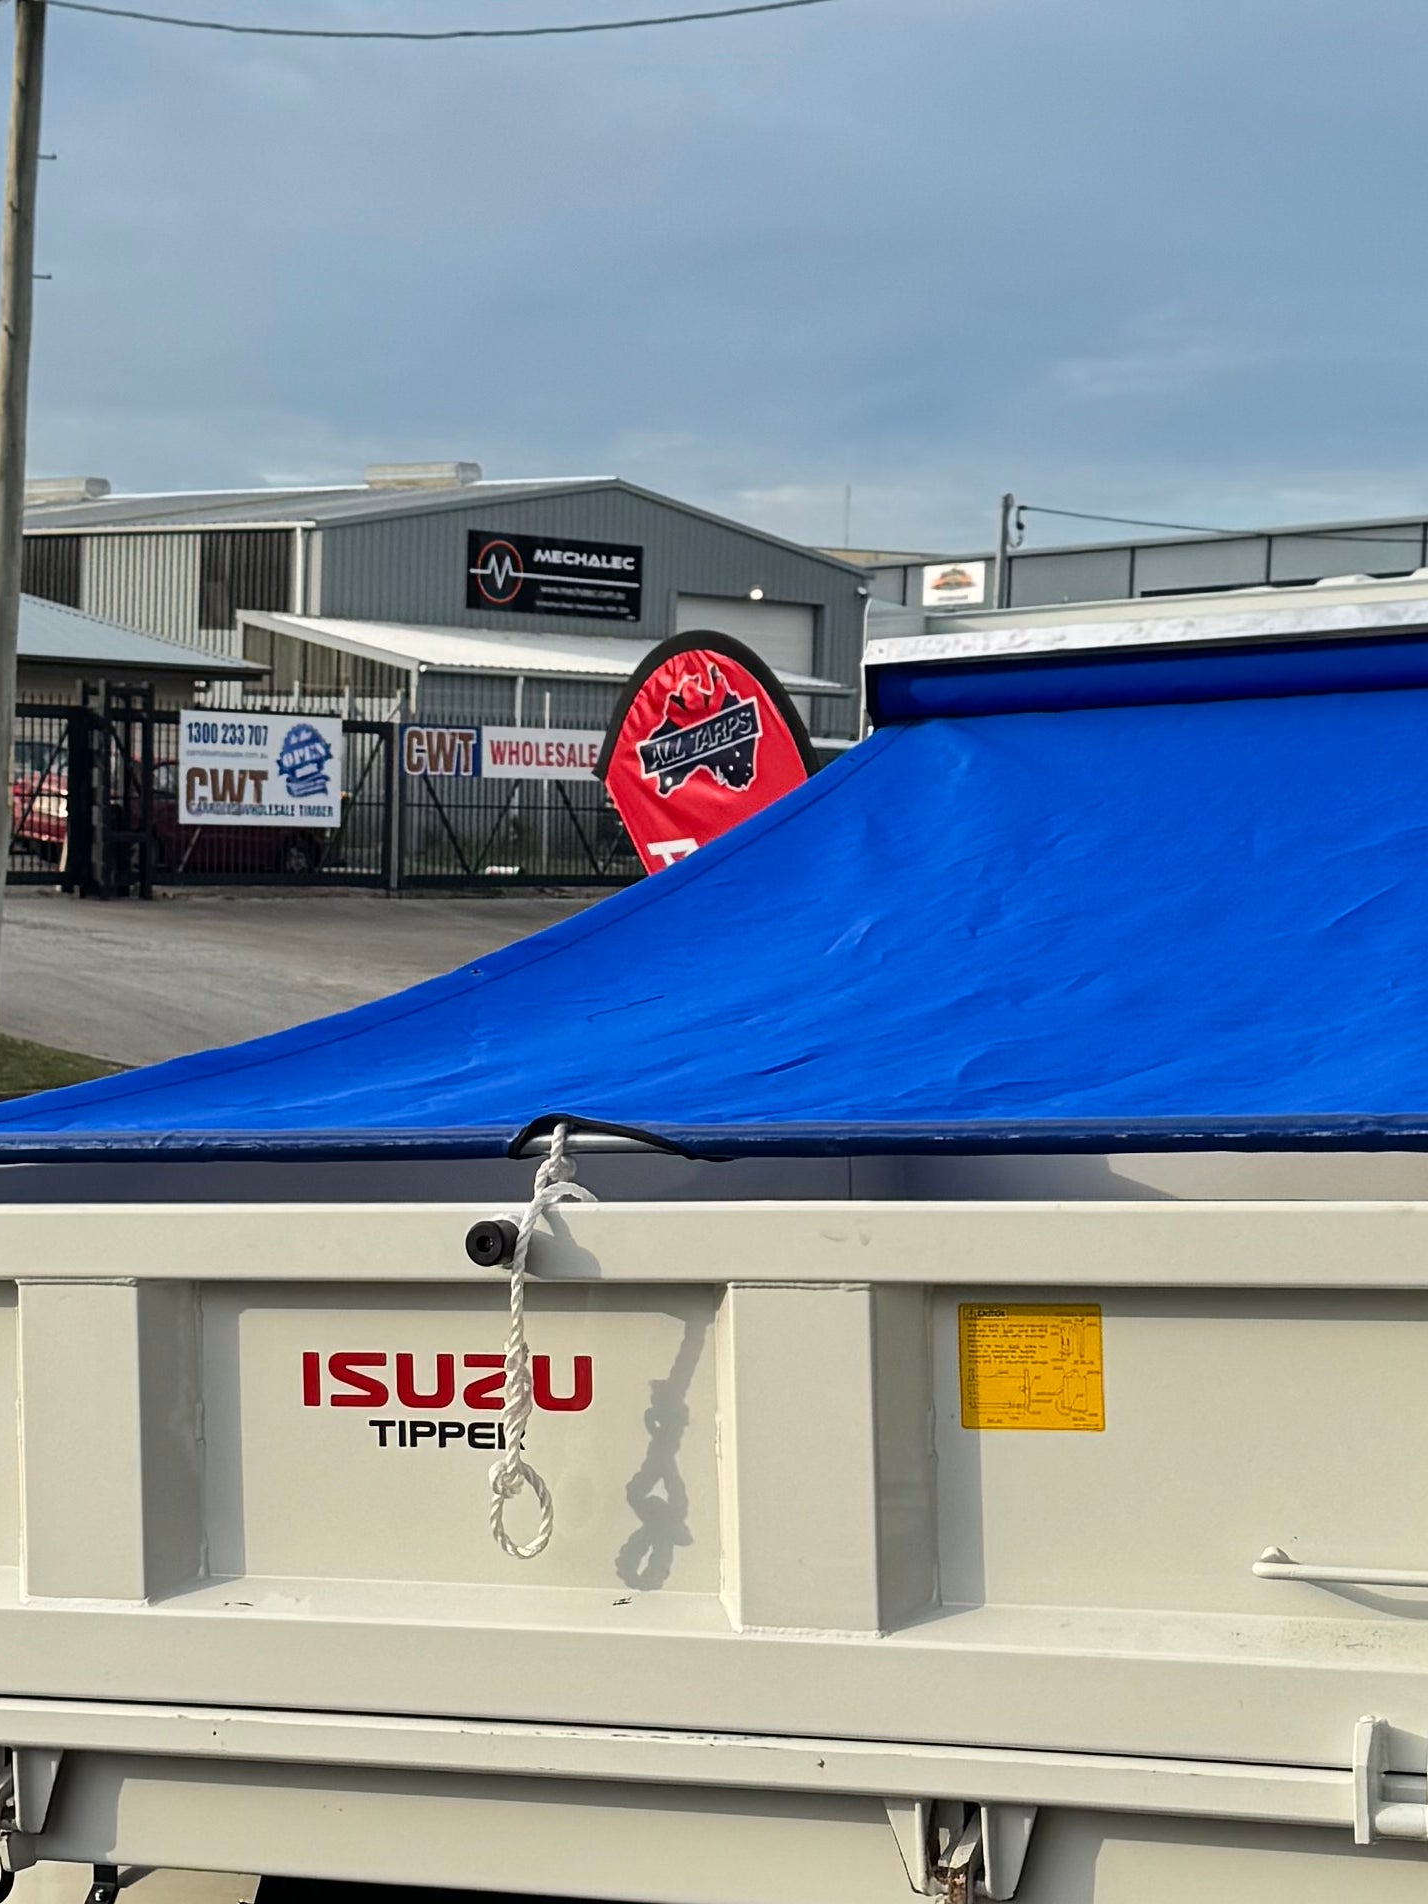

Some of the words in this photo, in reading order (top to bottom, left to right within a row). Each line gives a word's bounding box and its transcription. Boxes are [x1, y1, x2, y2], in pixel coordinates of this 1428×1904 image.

[533, 548, 636, 571] MECHALEC
[187, 722, 219, 744] 1300
[221, 723, 246, 746] 233
[248, 725, 269, 747] 707
[404, 726, 477, 776] CWT
[489, 739, 599, 768] WHOLESALE
[650, 741, 686, 771] ALL
[689, 711, 754, 755] TARPS
[186, 766, 269, 816] CWT
[299, 804, 334, 818] TIMBER
[303, 1351, 593, 1412] ISUZU
